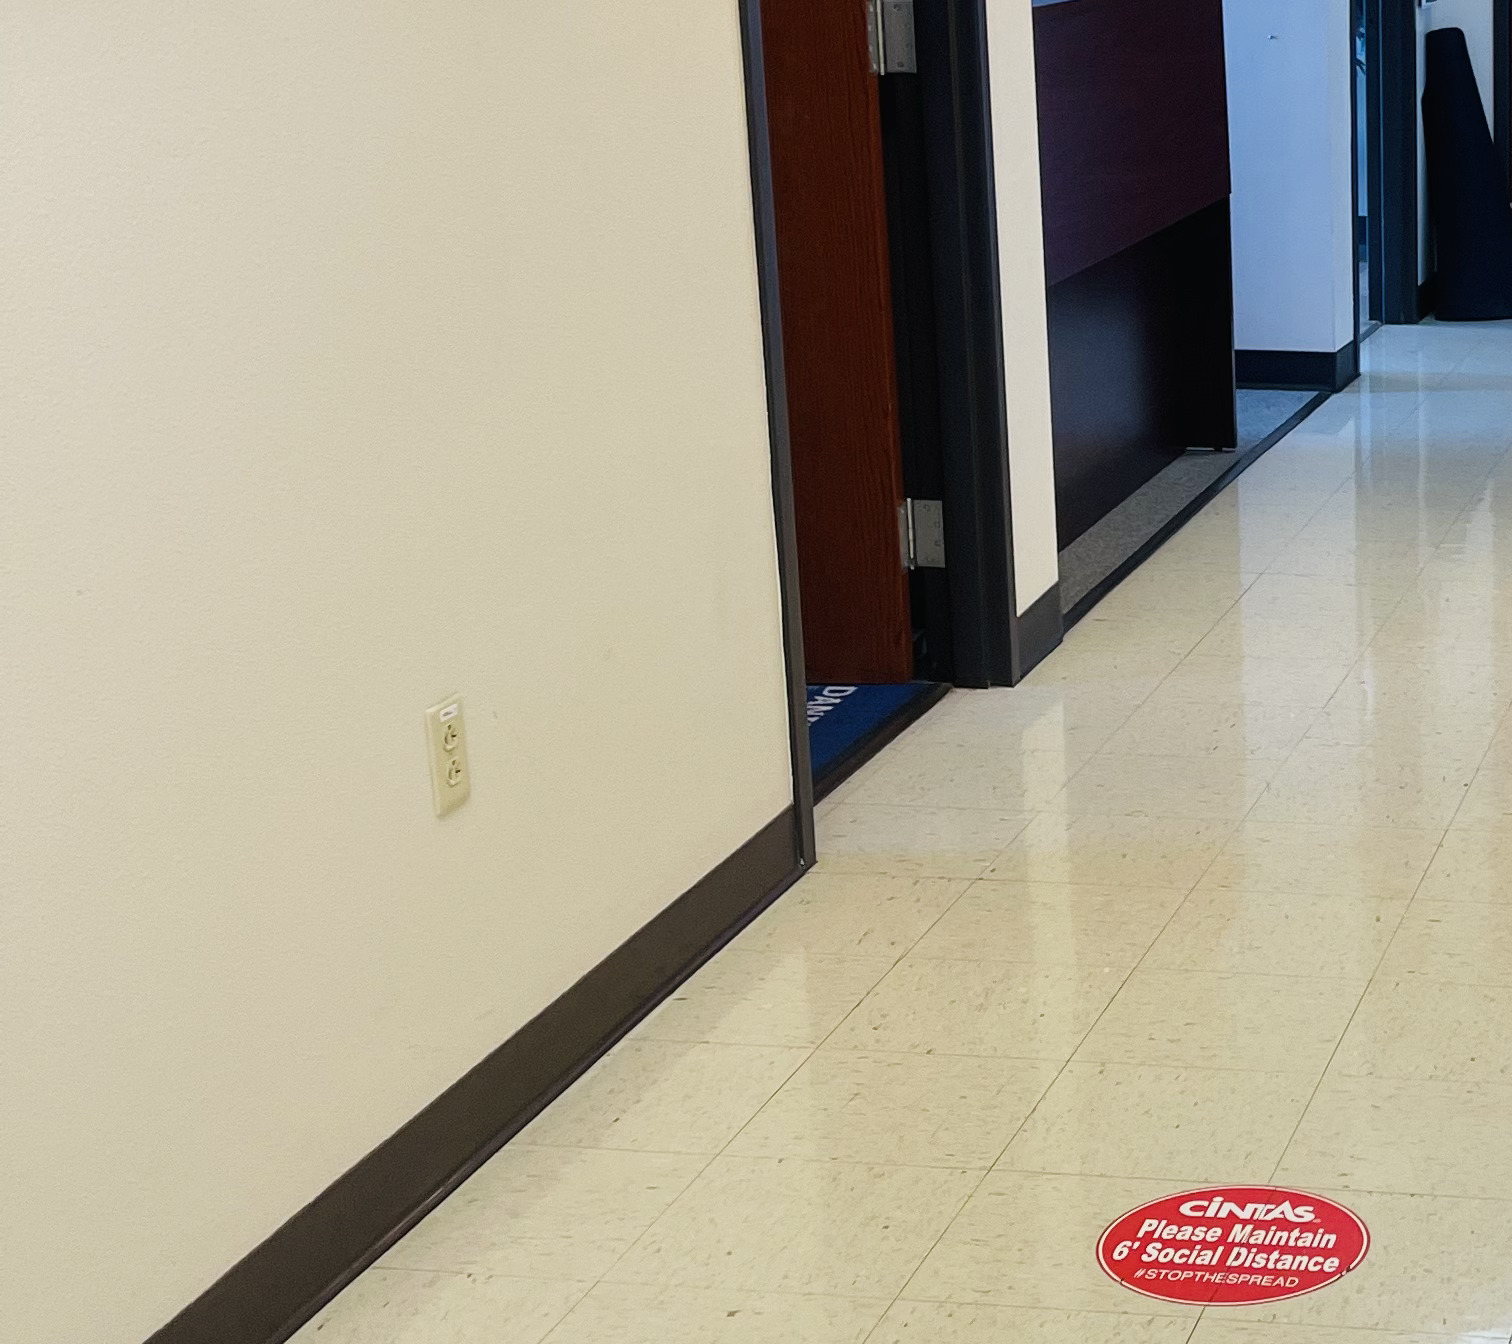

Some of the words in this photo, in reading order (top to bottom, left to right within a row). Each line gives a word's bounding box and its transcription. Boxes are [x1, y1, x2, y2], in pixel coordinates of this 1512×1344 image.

[1136, 1219, 1222, 1242] Please
[1227, 1224, 1336, 1248] Maintain
[1112, 1240, 1140, 1260] 6'
[1141, 1242, 1224, 1265] Social
[1226, 1246, 1340, 1272] Distance
[1134, 1268, 1299, 1287] #STOPTHESPREAD
